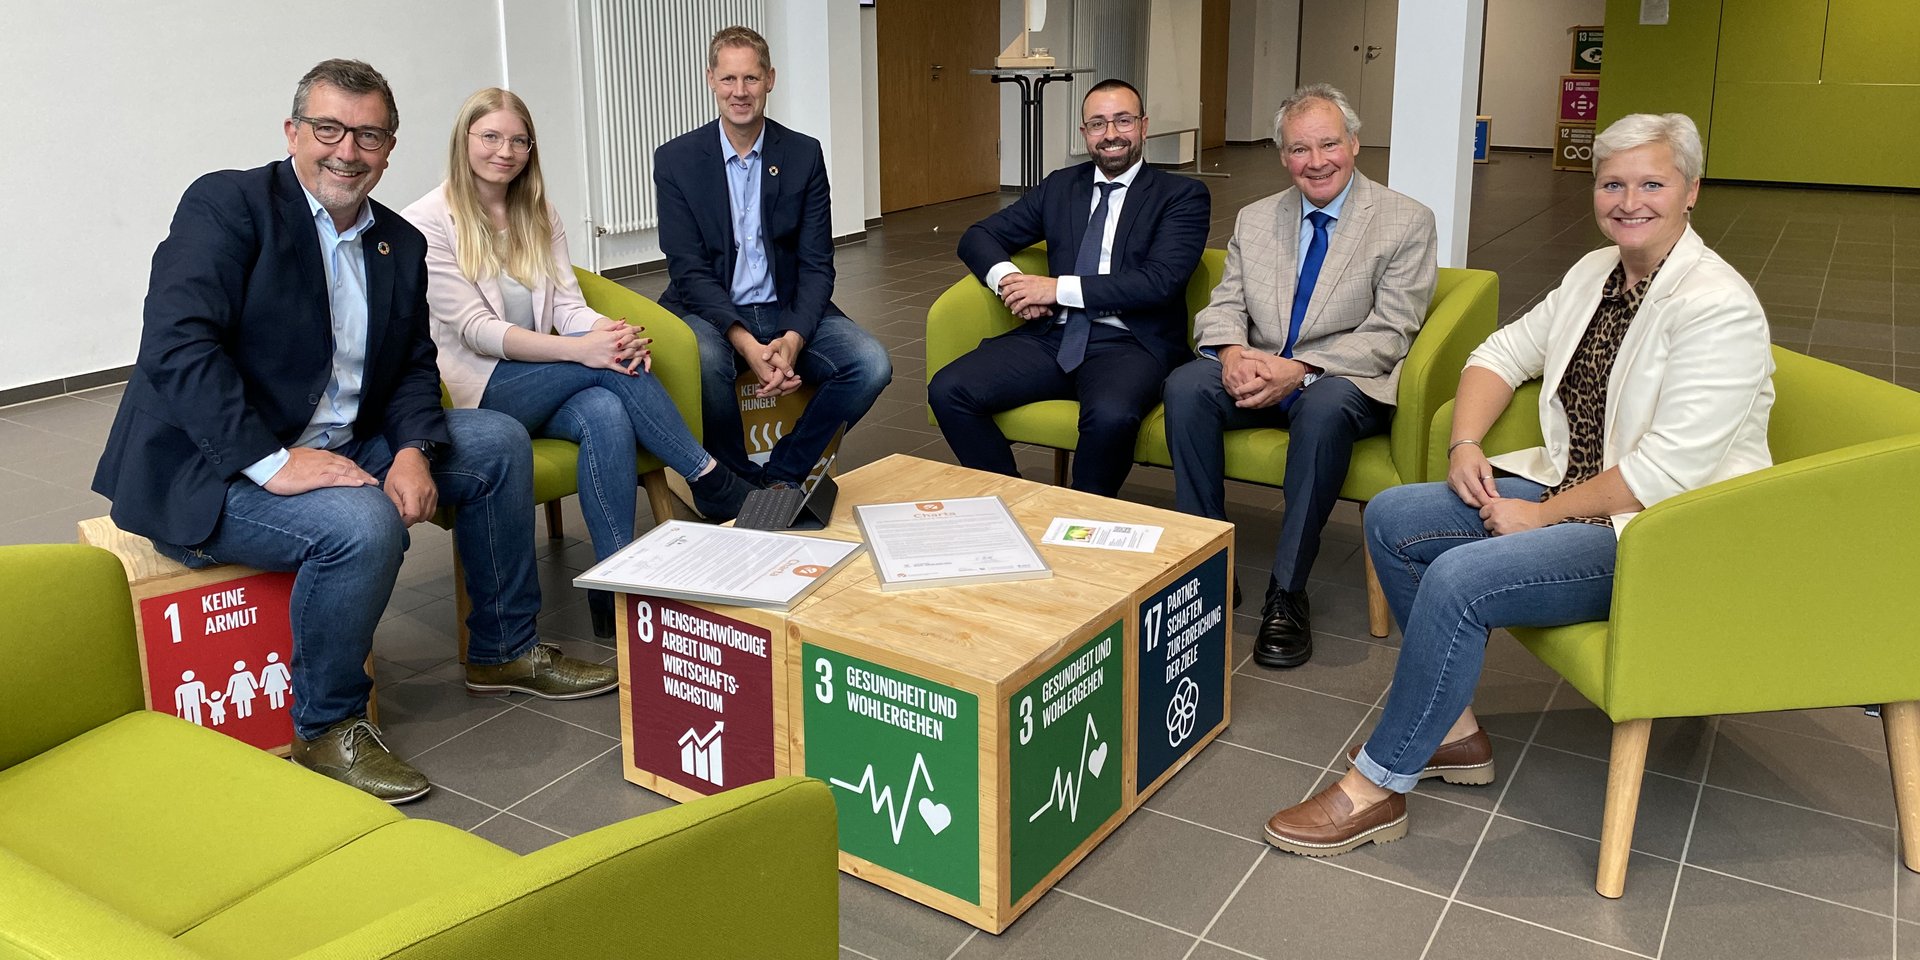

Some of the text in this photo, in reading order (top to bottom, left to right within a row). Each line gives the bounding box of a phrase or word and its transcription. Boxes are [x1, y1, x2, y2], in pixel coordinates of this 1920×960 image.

[1579, 32, 1587, 41] 13
[1565, 82, 1574, 91] 10
[1561, 128, 1569, 138] 12
[741, 383, 761, 396] KEIN
[741, 396, 776, 411] HUNGER
[201, 587, 246, 613] KEINE
[1166, 577, 1201, 615] PARTNER-
[1166, 596, 1203, 638] SCHAFTEN
[164, 603, 182, 643] 1
[205, 607, 258, 636] ARMUT
[637, 600, 654, 643] 8
[661, 606, 767, 658] MENSCHENWÜRDIGE
[1144, 601, 1163, 653] 17
[1166, 605, 1222, 661] ZUR ERREICHUNG
[661, 630, 722, 667] ARBEIT UND
[1165, 643, 1199, 685] DER ZIELE
[662, 652, 740, 695] WIRTSCHAFTS-
[815, 657, 834, 704] 3
[1042, 637, 1112, 703] GESUNDHEIT UND
[663, 675, 724, 714] WACHSTUM
[846, 665, 958, 720] GESUNDHEIT UND
[1042, 666, 1104, 729] WOHLERGEHEN
[846, 690, 944, 742] WOHLERGEHEN
[1019, 695, 1034, 746] 3
